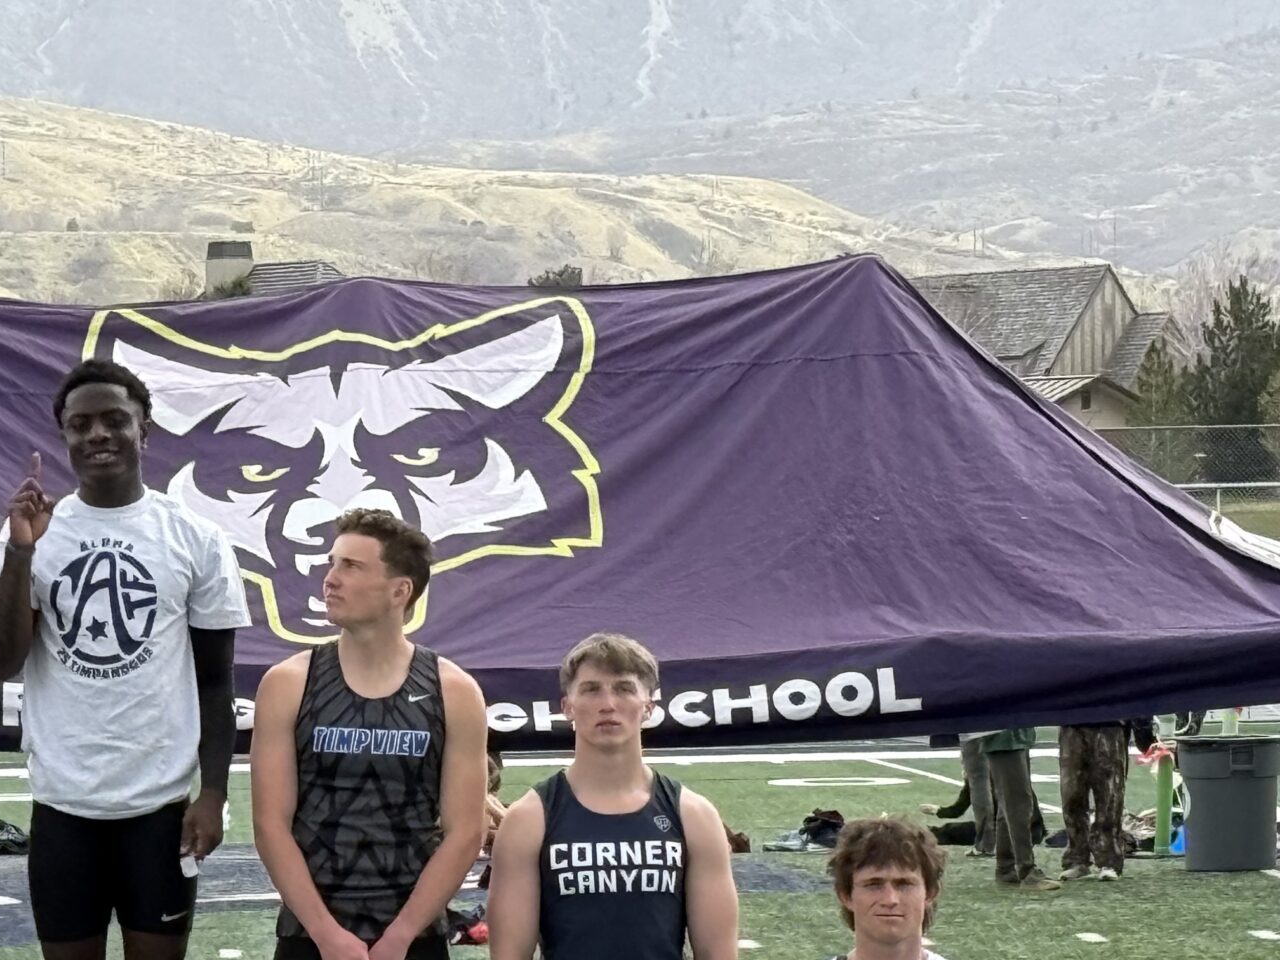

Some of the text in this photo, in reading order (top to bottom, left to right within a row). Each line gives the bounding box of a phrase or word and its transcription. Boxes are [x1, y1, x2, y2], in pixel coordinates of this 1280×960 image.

[312, 725, 431, 758] TIMPVIEW
[549, 840, 683, 870] CORNER
[558, 869, 677, 896] CANYON
